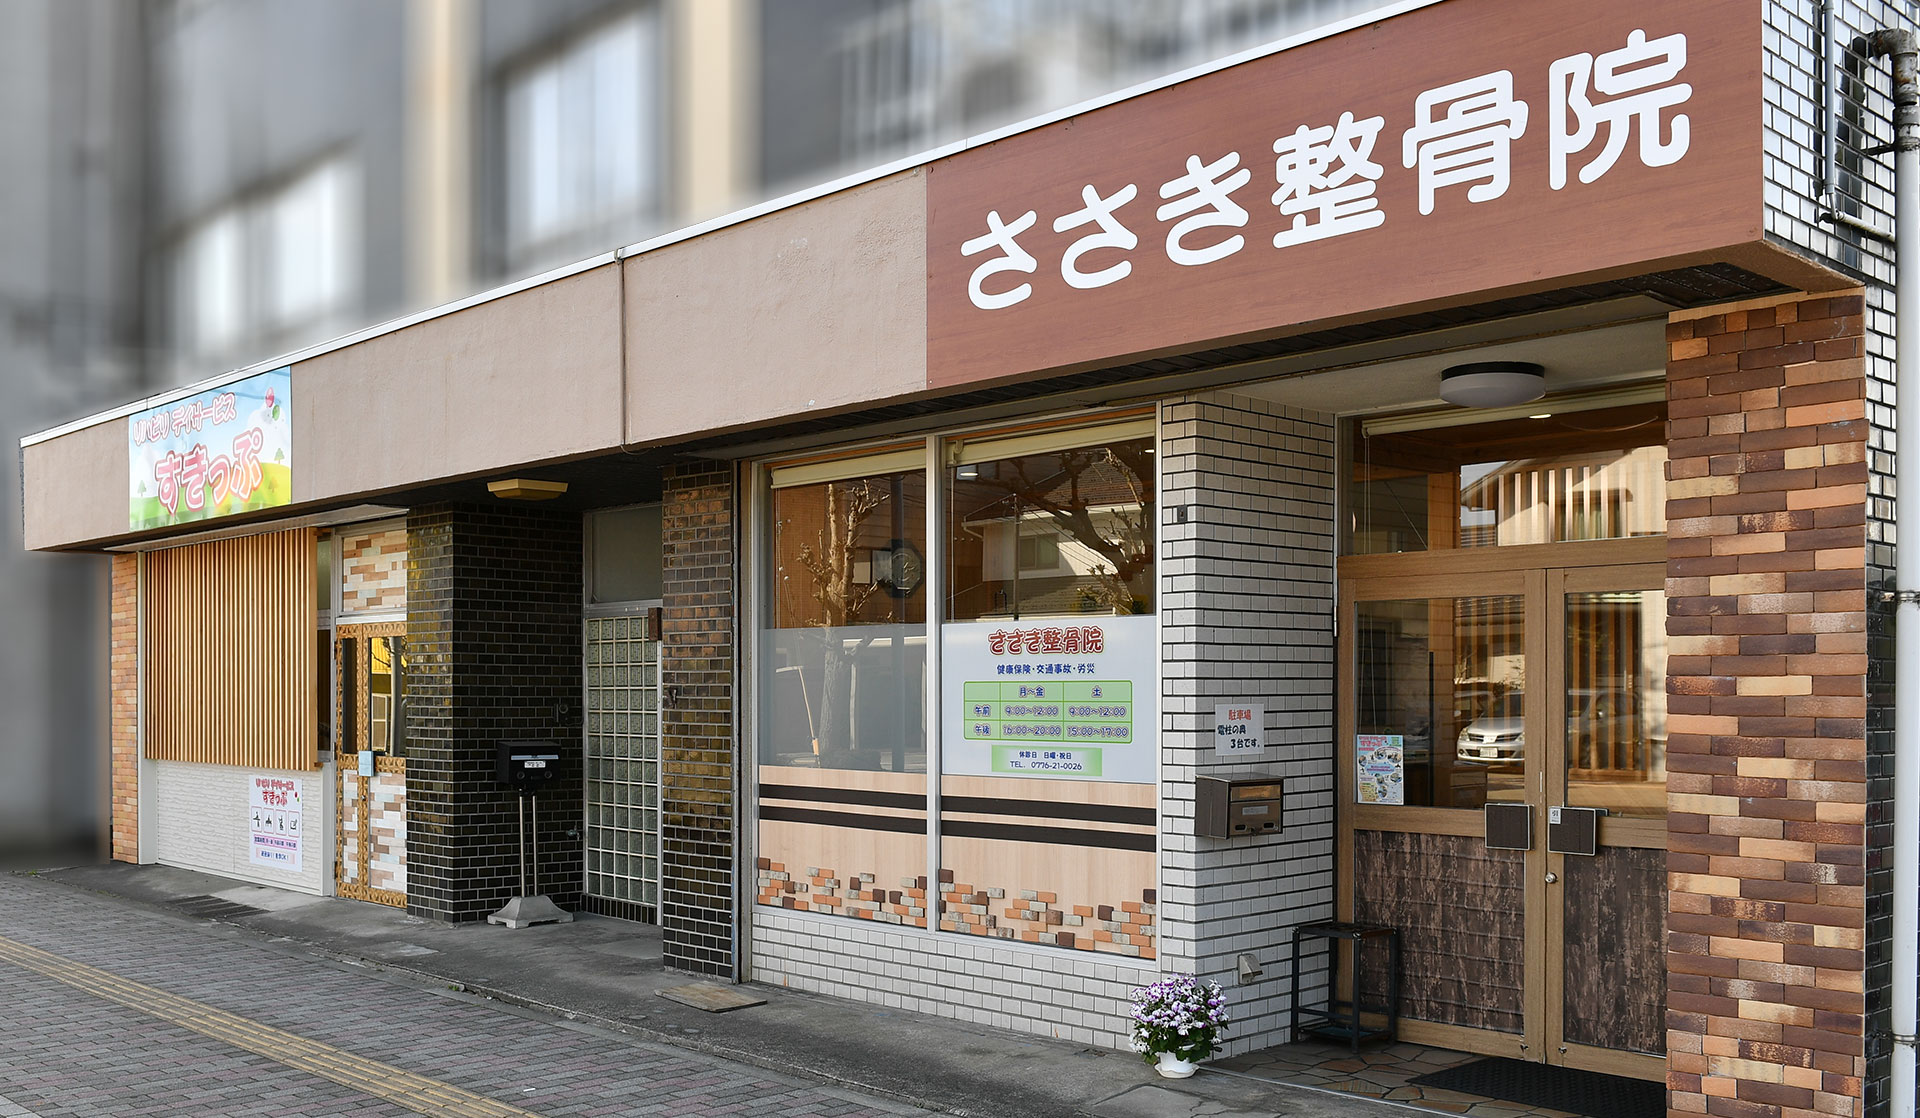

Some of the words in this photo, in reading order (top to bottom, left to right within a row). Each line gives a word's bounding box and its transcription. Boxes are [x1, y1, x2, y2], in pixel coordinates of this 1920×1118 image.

[961, 28, 1692, 310] ささき整骨院
[134, 412, 171, 446] リハビリ
[172, 392, 238, 437] デイサービス
[155, 427, 263, 516] すきっぷ
[988, 626, 1104, 655] ささき整骨院
[997, 663, 1095, 675] 健康保険・交通事故・労災
[1092, 686, 1102, 698] 土
[974, 705, 991, 716] 午前
[1228, 709, 1251, 721] 駐車場
[974, 724, 991, 736] 午後
[1044, 751, 1072, 760] 日曜・祝日
[1031, 761, 1083, 770] 0776-21-0026
[262, 791, 287, 806] すきっぷ
